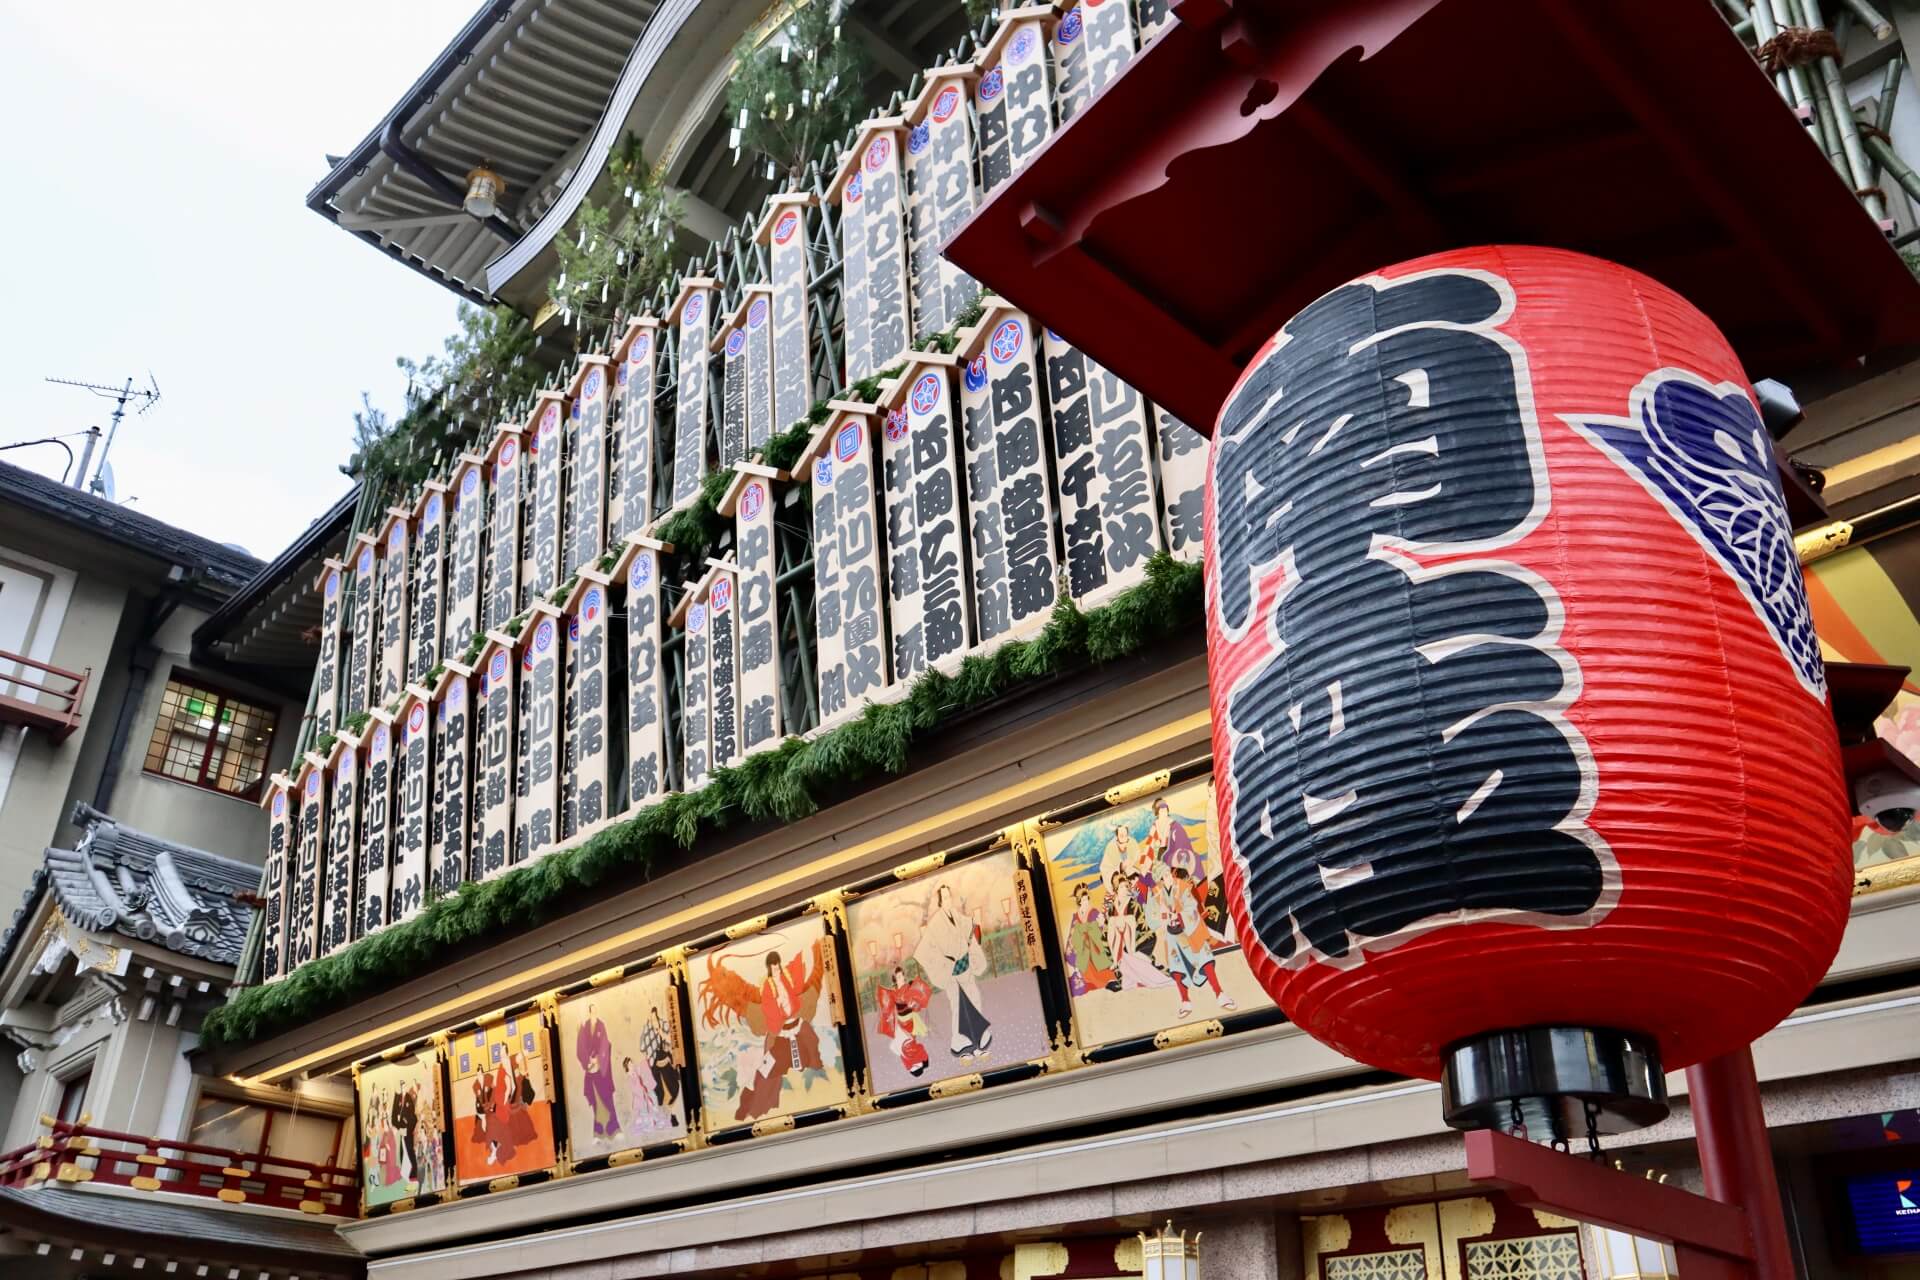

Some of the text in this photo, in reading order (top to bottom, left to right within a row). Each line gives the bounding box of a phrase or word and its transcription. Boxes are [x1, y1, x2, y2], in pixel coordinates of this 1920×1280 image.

[835, 462, 883, 698] 市川九團次
[1210, 270, 1613, 965] 南座
[264, 821, 285, 980] 市川團十郎
